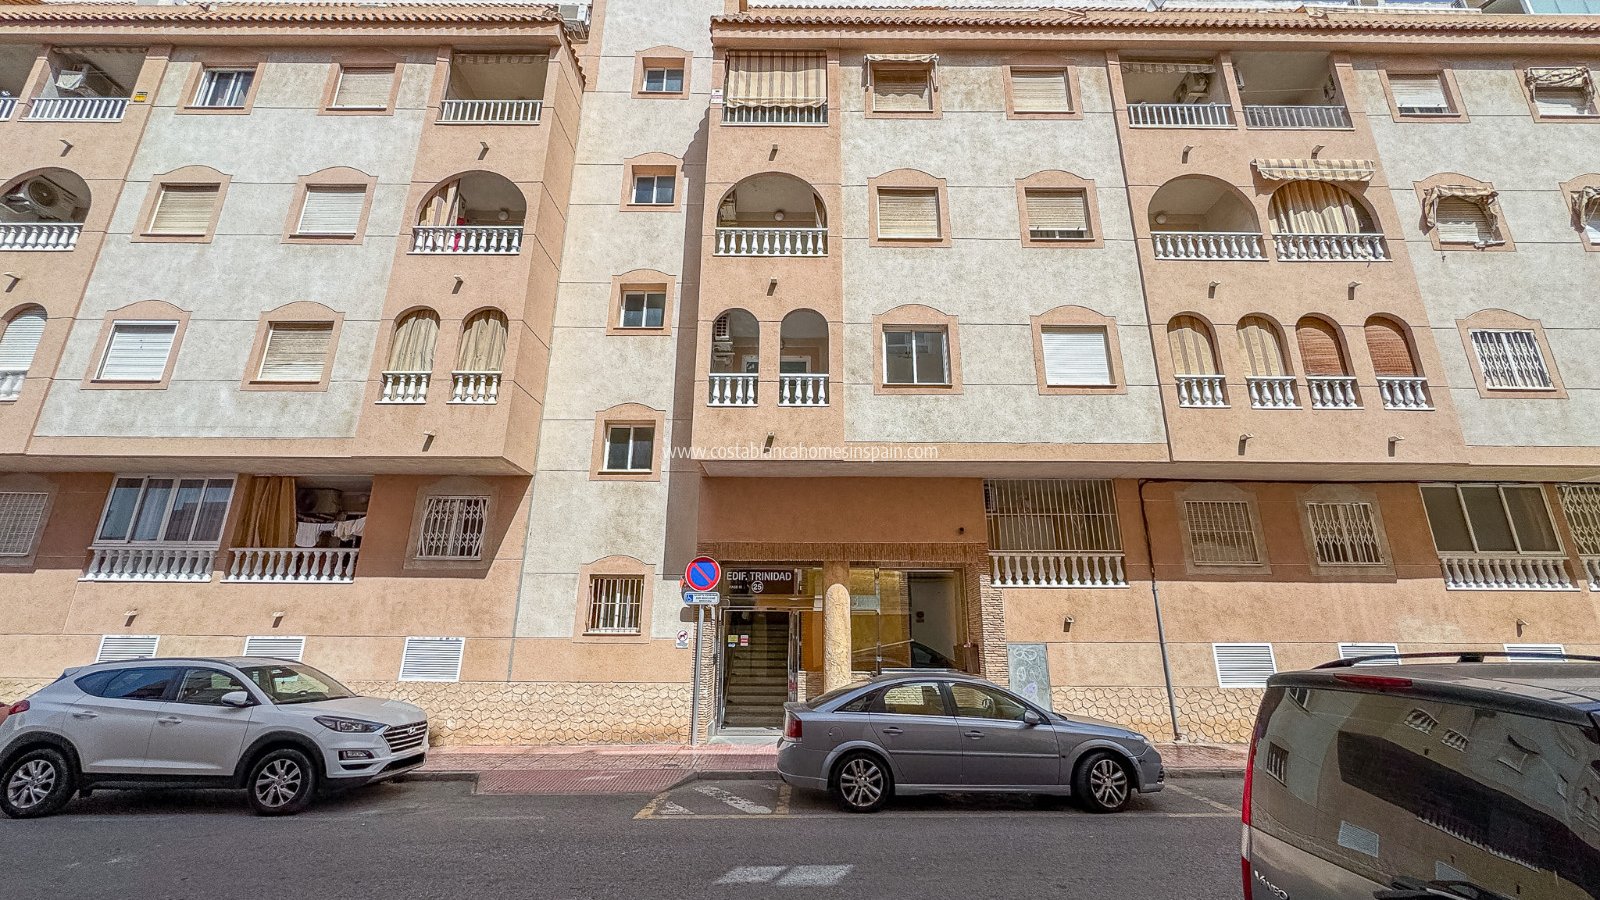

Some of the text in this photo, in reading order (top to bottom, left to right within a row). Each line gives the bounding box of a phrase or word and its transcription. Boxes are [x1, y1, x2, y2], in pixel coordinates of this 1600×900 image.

[726, 571, 792, 581] EDIF. TRINIDAD
[753, 583, 762, 591] 25
[1254, 870, 1288, 900] VANEO
